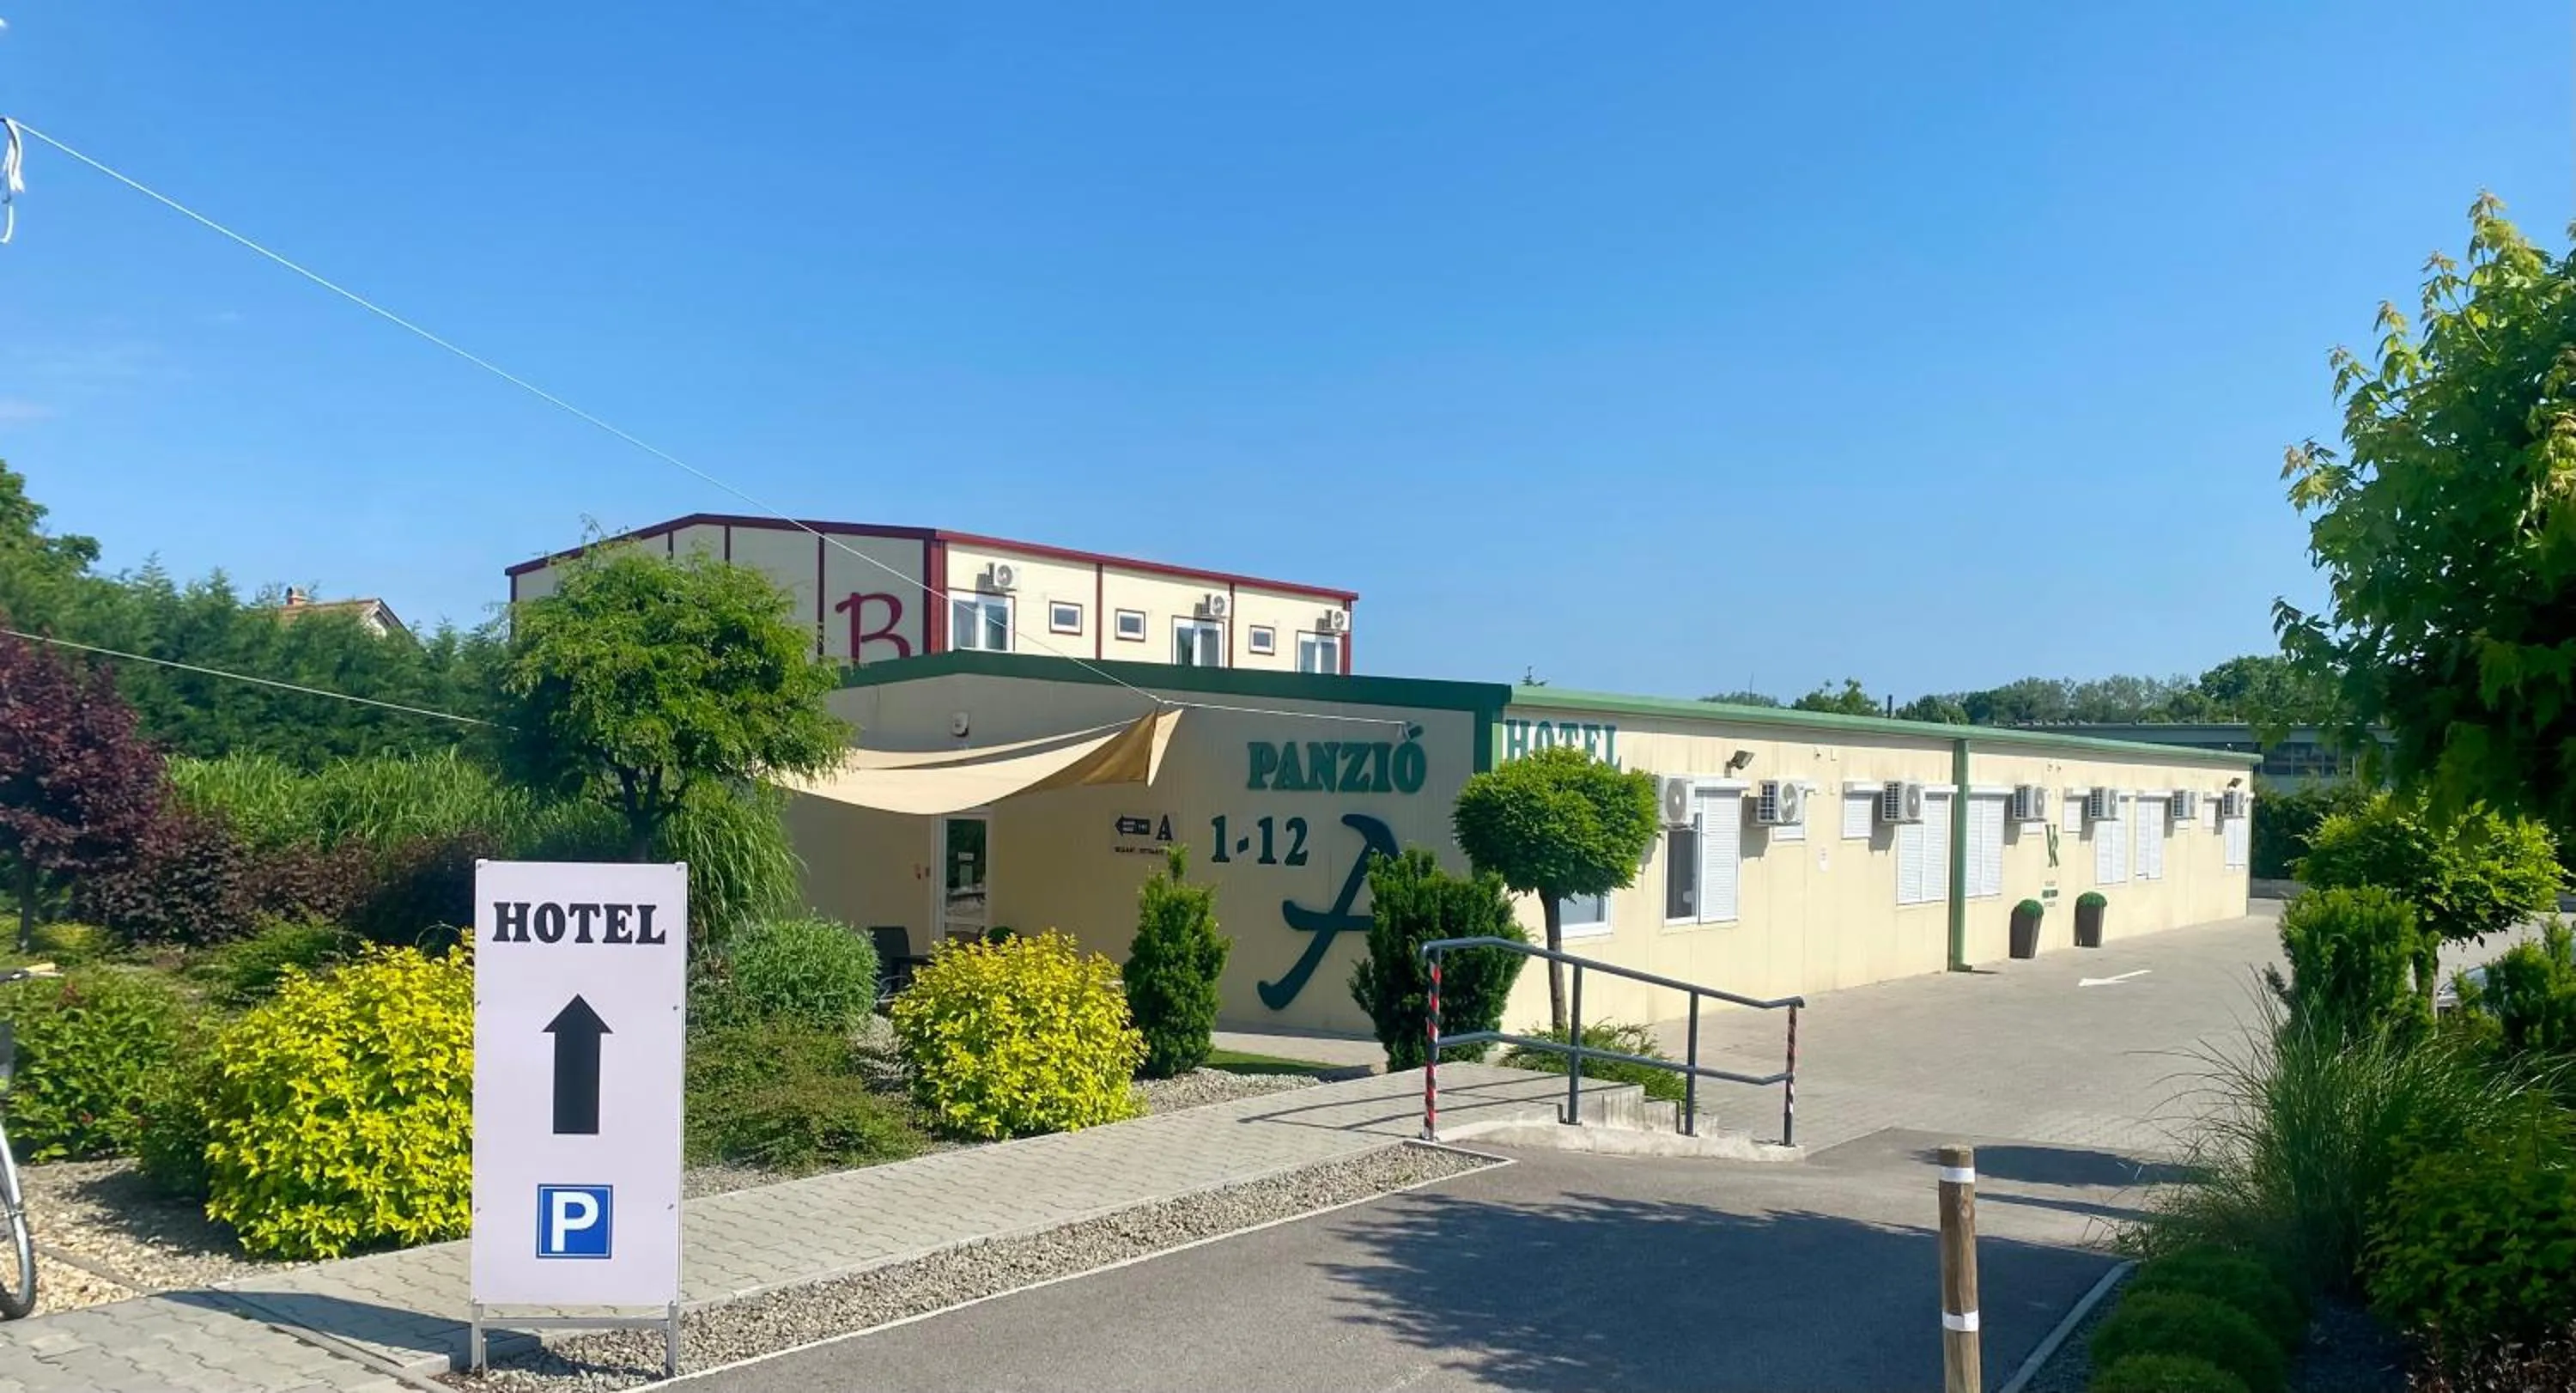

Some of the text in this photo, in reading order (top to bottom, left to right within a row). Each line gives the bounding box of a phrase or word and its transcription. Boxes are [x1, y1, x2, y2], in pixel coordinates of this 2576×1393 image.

[835, 592, 911, 661] B
[1248, 725, 1426, 794] PANZIÓ
[1156, 813, 1174, 841] A
[1211, 815, 1309, 866] 1-12
[492, 901, 666, 945] HOTEL
[551, 1191, 598, 1251] P
